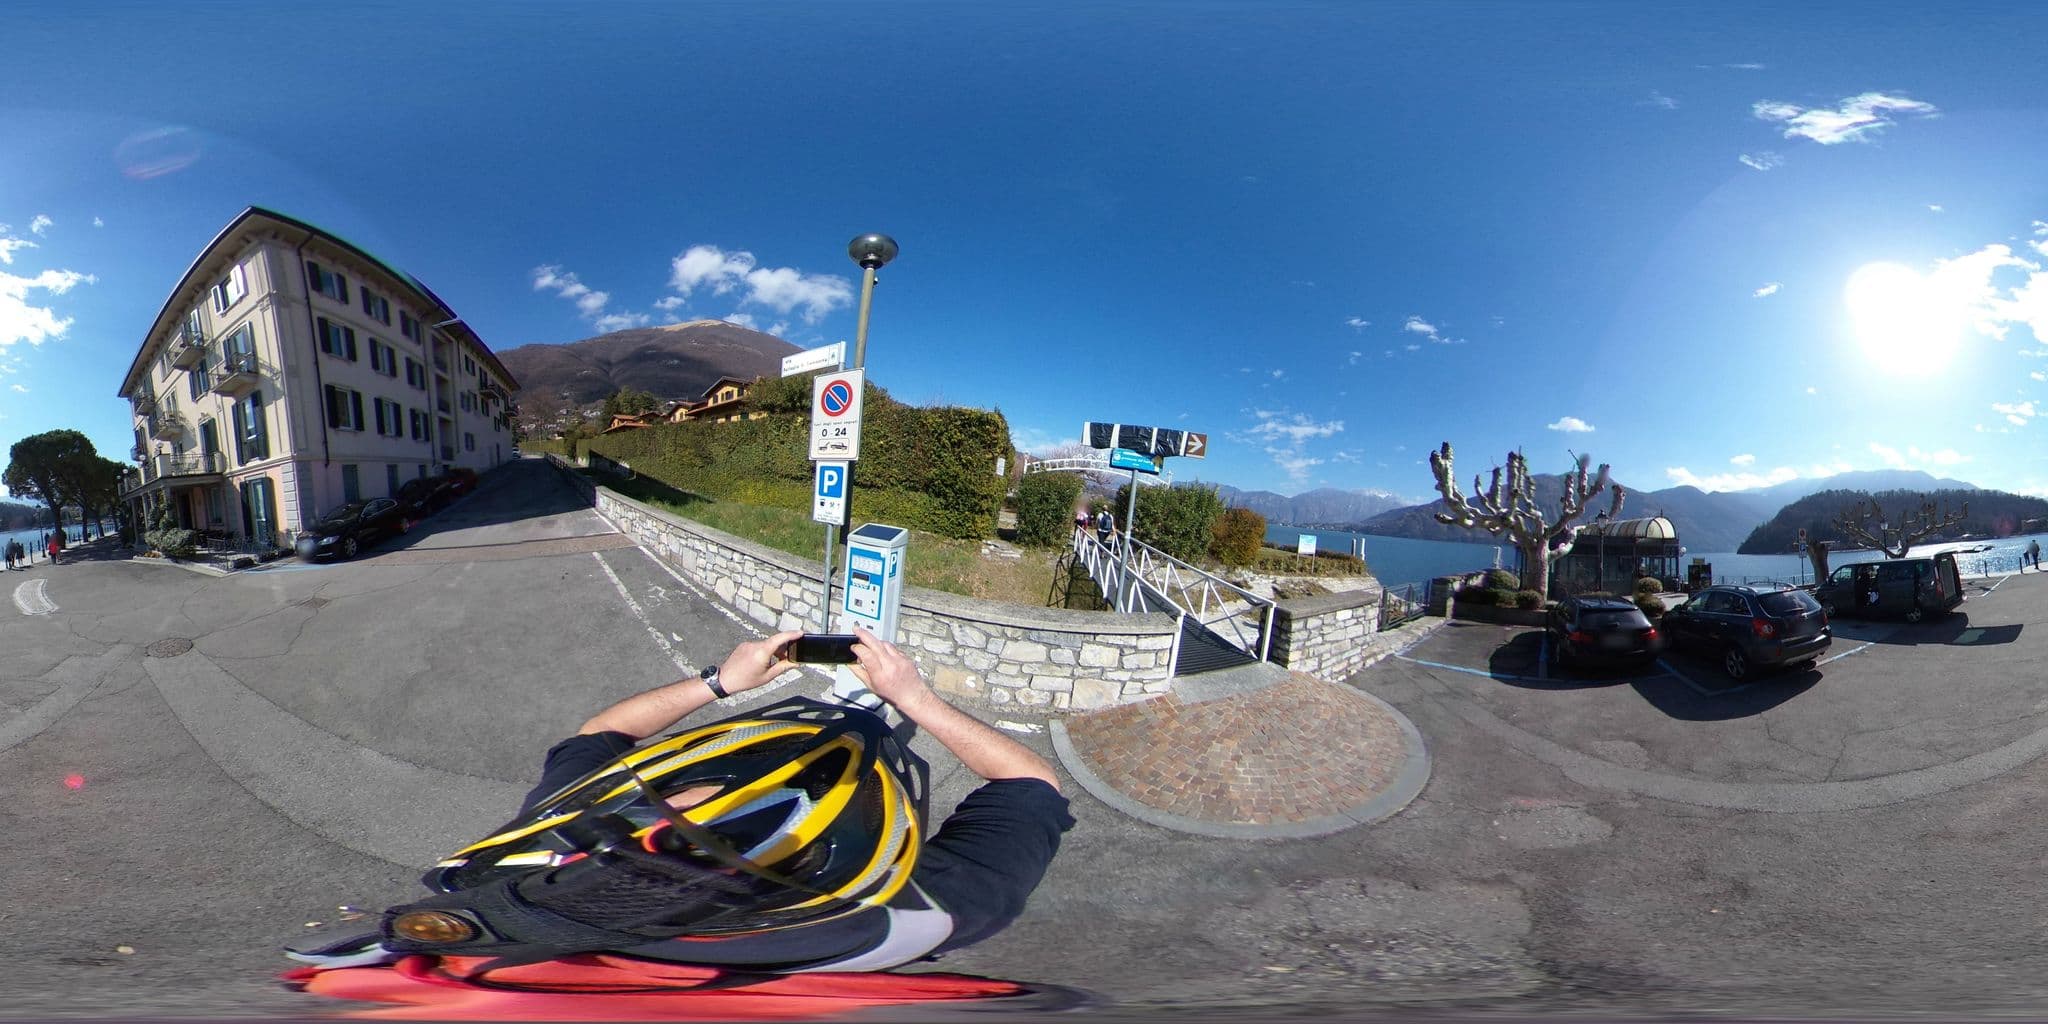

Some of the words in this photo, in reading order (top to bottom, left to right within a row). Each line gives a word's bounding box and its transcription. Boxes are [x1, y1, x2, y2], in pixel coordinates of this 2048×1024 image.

[821, 428, 828, 437] 0
[834, 427, 847, 436] 24
[823, 470, 839, 494] P
[889, 553, 898, 574] P
